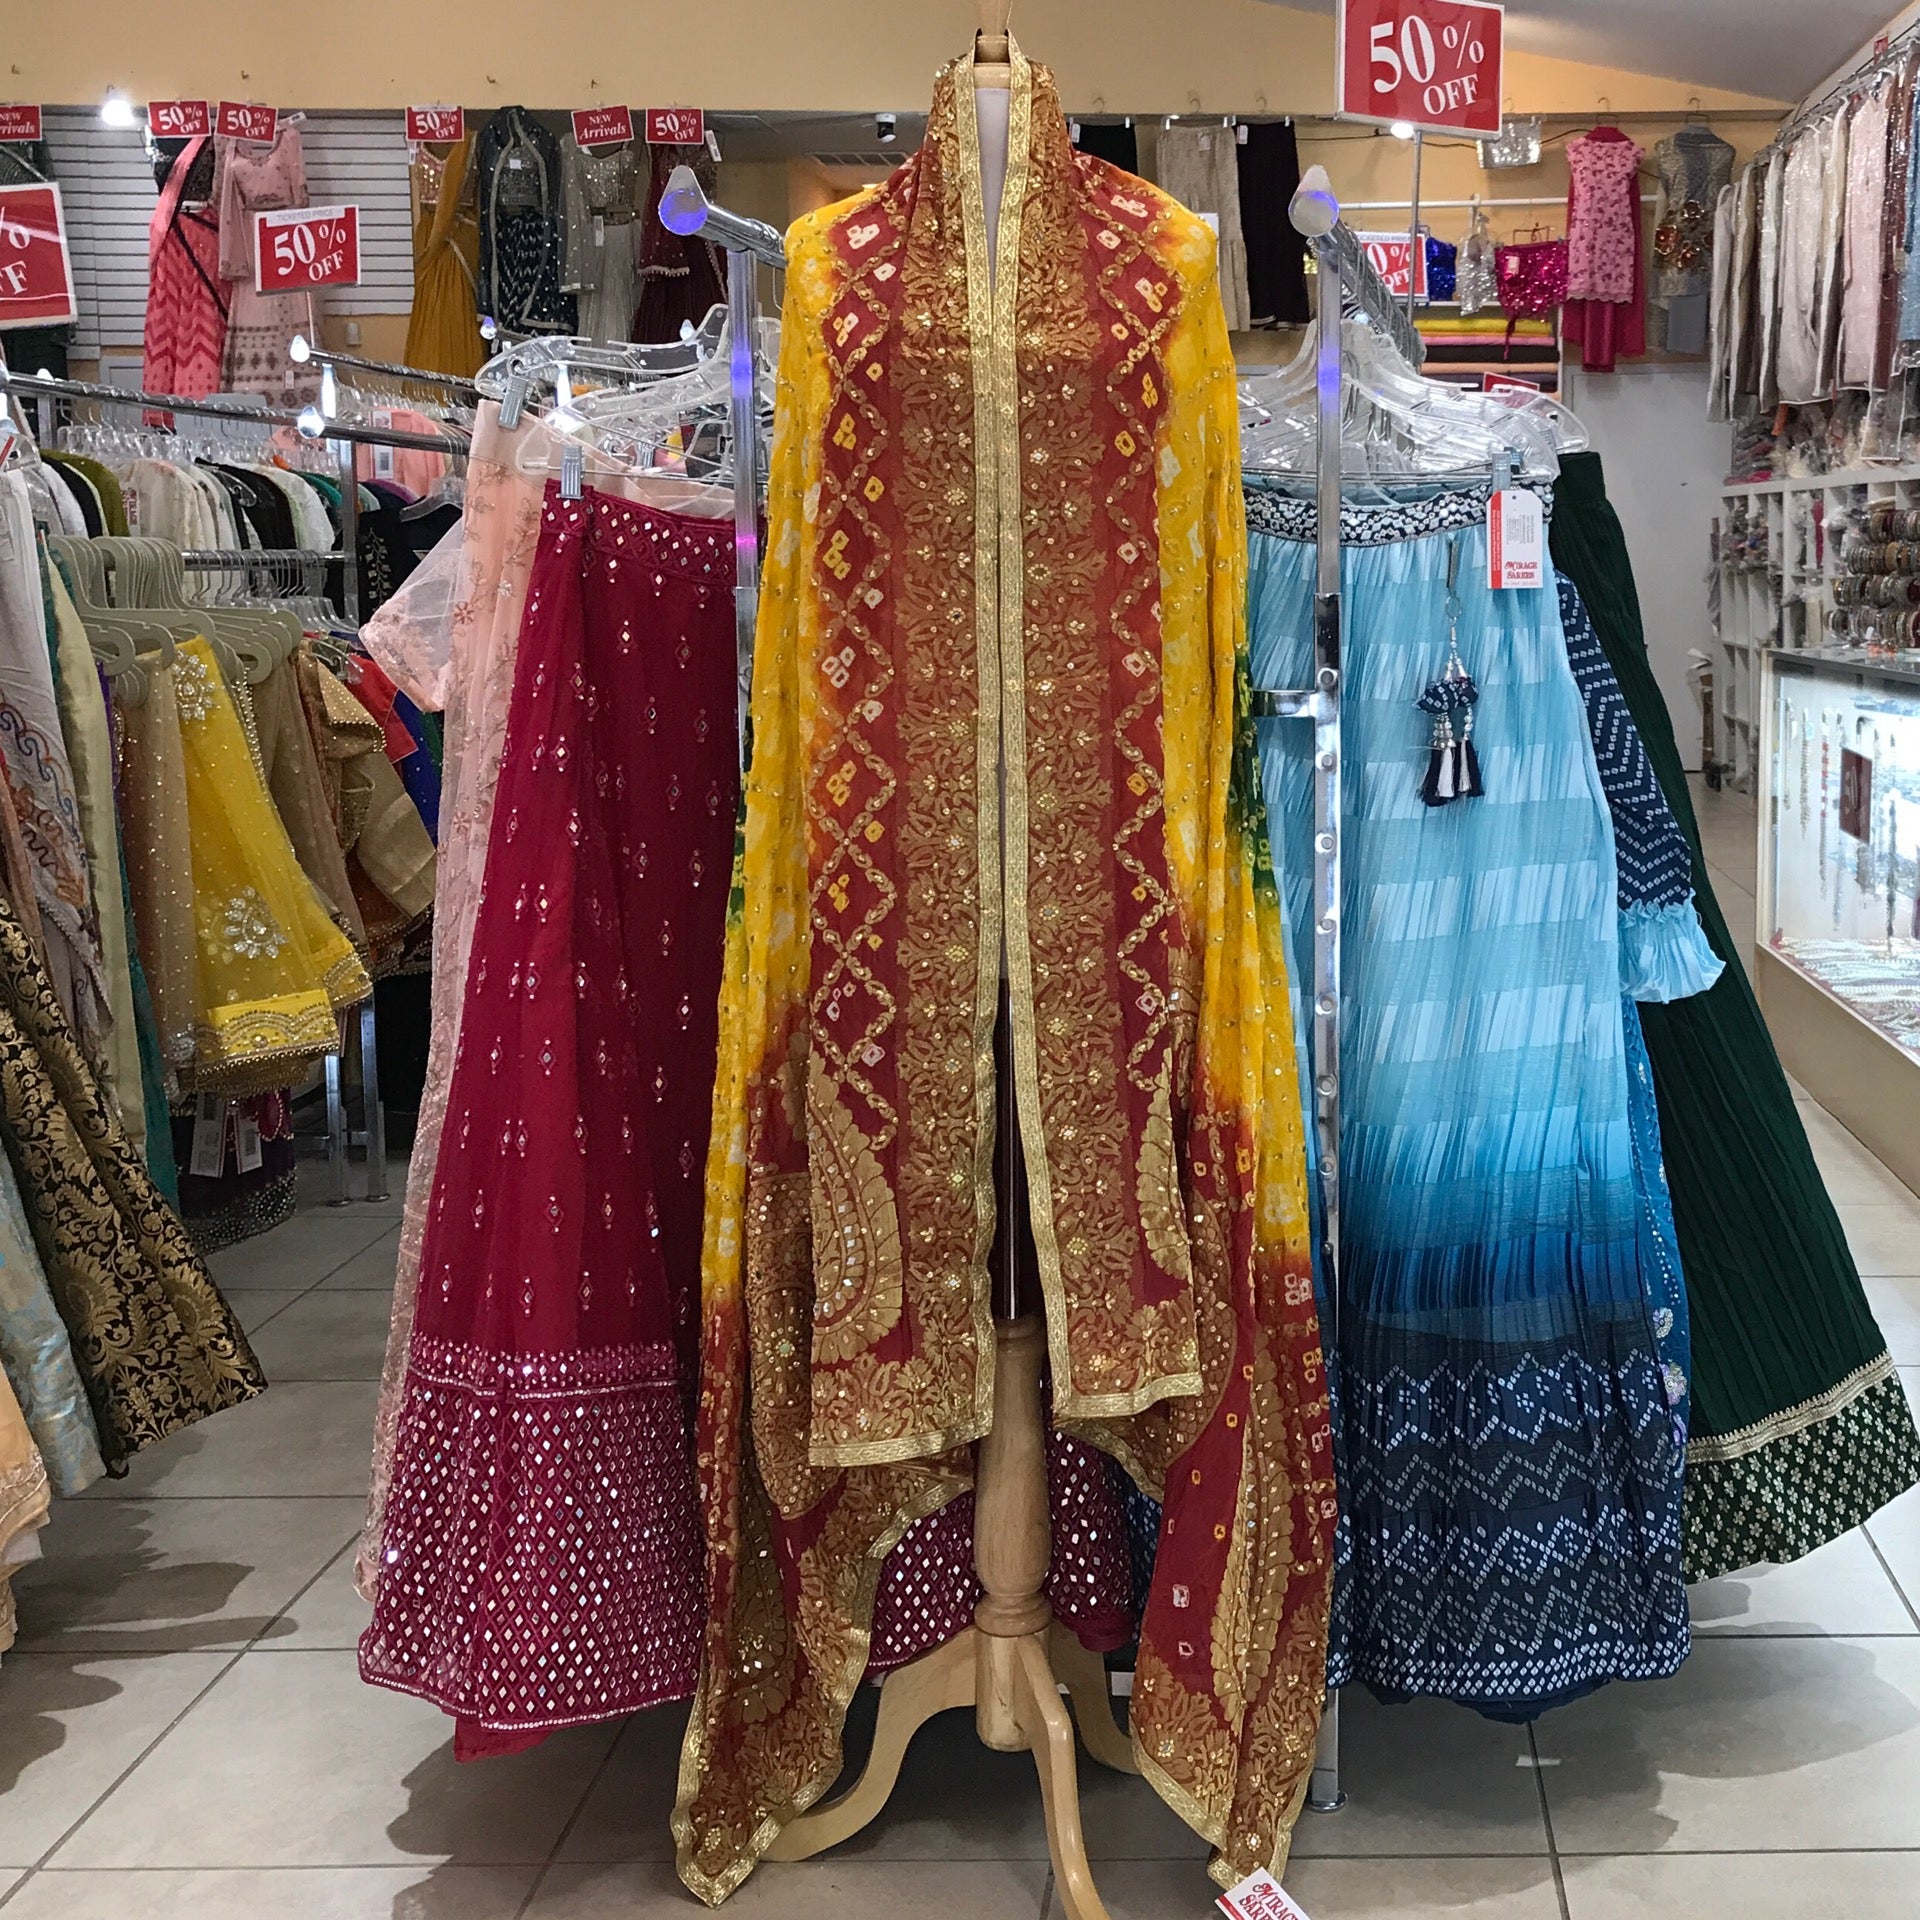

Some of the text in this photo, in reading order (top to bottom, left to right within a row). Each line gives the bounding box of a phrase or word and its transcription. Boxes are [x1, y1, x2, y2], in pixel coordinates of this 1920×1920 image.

[1370, 14, 1485, 93] 50%
[1423, 74, 1479, 115] OFF
[180, 120, 202, 134] OFF
[588, 114, 612, 125] NEW
[245, 125, 268, 137] OFF
[435, 124, 456, 139] OFF
[579, 122, 627, 140] Arrivals
[674, 127, 697, 141] OFF
[274, 218, 347, 276] 50%
[308, 249, 344, 281] OFF
